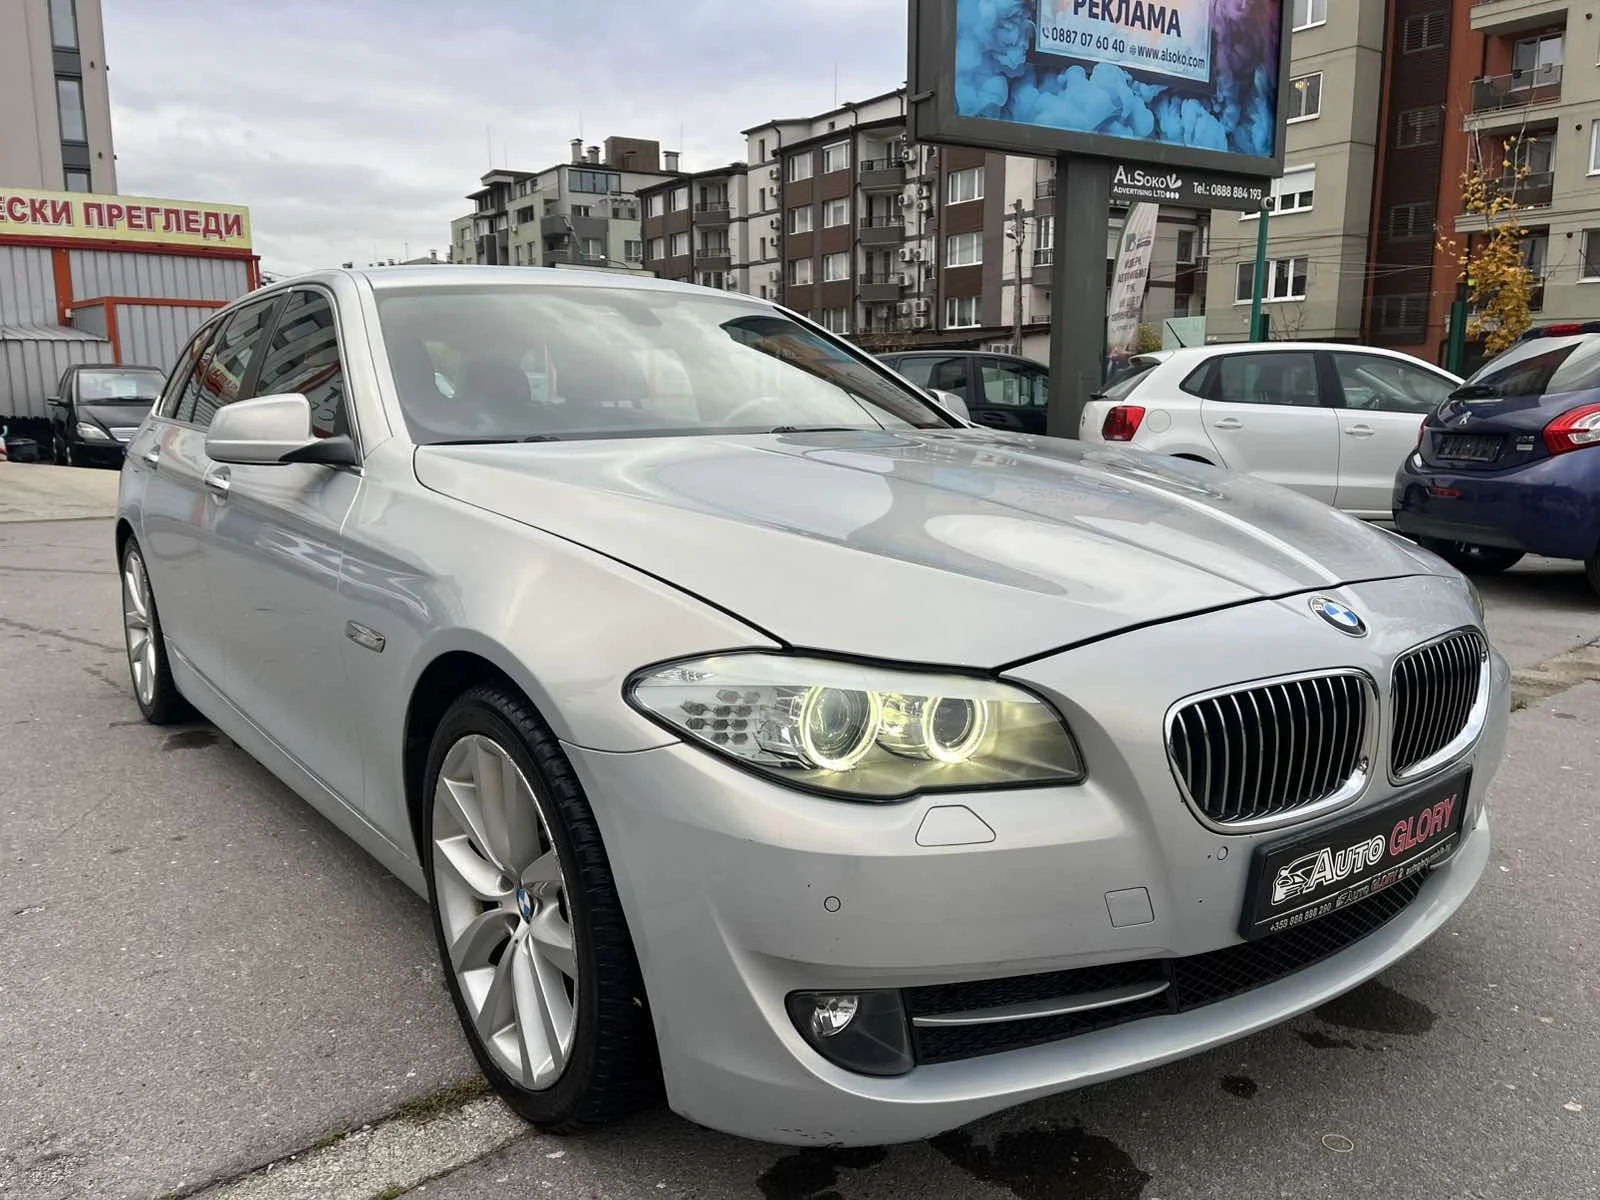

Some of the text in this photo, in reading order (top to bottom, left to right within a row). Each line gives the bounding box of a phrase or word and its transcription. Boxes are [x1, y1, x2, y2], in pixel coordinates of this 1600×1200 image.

[1073, 0, 1182, 37] РЕКЛАМА
[1051, 27, 1205, 69] 0887 07 60 40 www.alsoko.com
[1113, 185, 1166, 198] ADVERTISING LTD
[1193, 182, 1262, 200] Tel.: 0888 884 193
[0, 196, 244, 240] СКИ ПРЕГЛЕДИ
[1303, 794, 1457, 894] AUTO GLORY
[1270, 919, 1288, 932] +359
